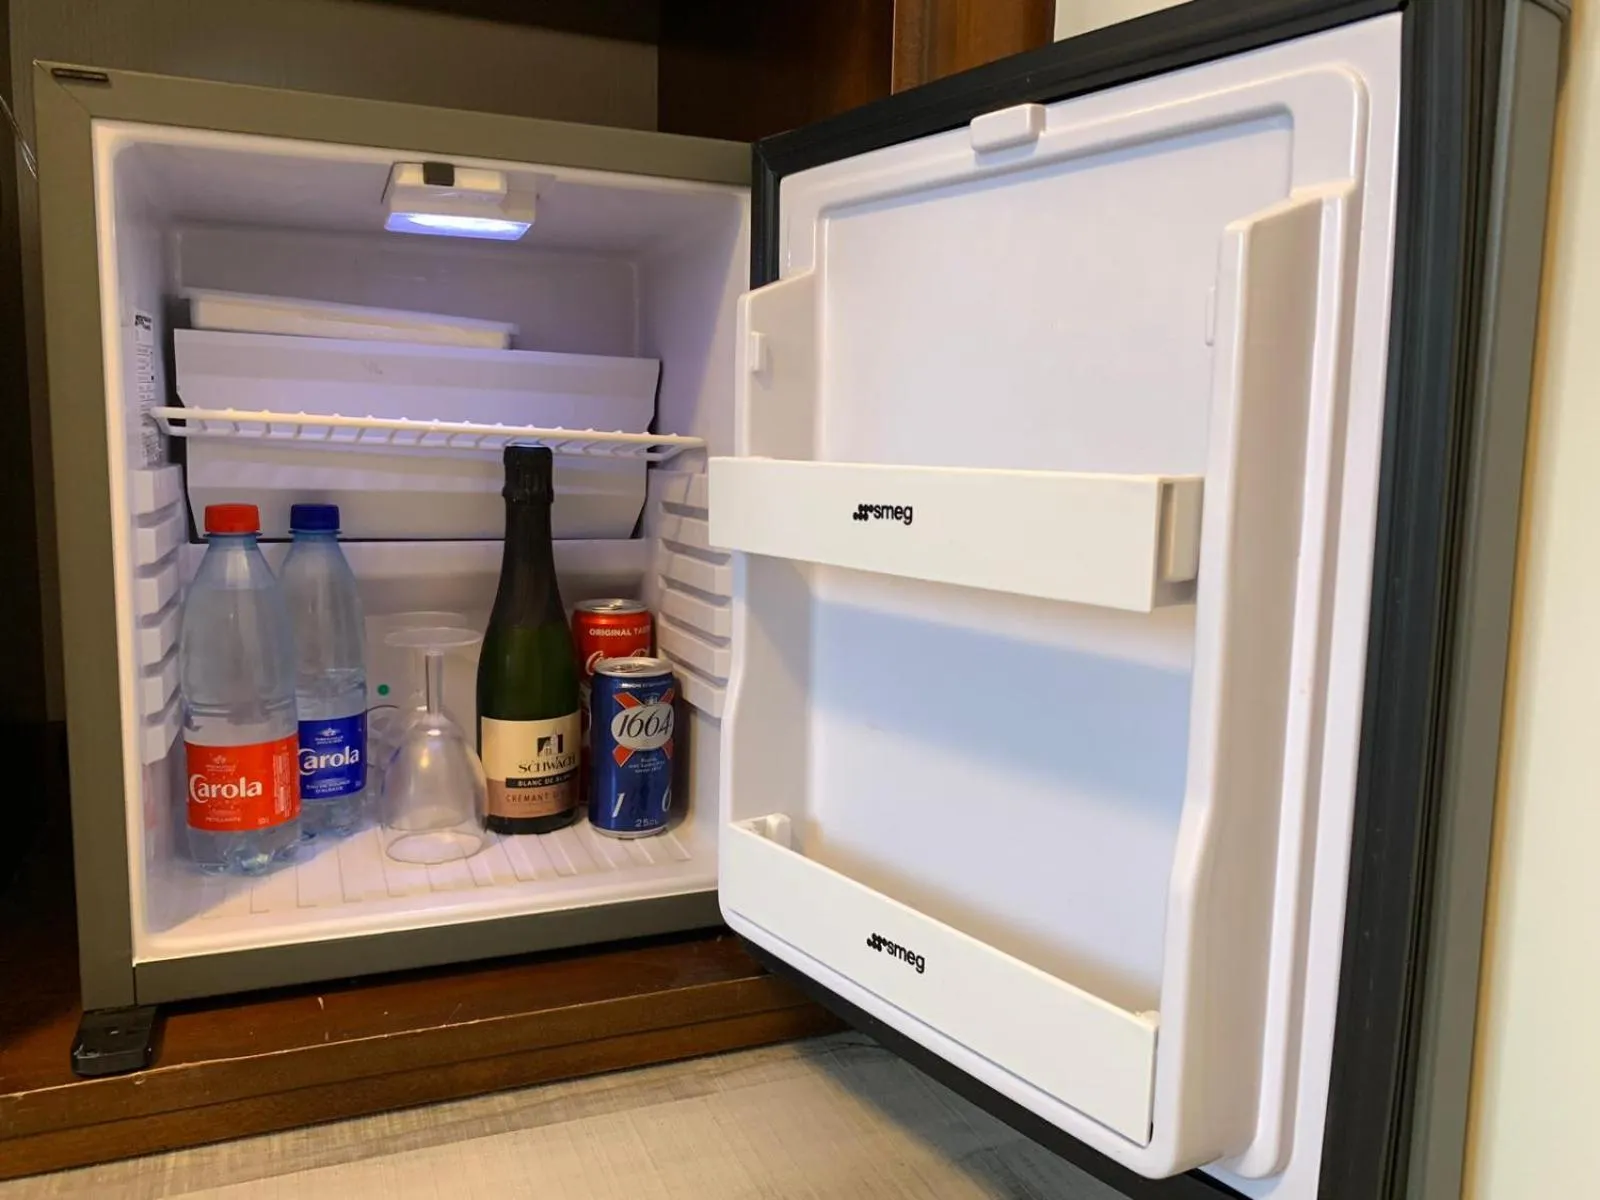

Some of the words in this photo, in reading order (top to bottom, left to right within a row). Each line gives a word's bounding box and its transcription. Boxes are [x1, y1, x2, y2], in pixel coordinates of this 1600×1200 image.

[873, 504, 913, 526] smeg
[589, 627, 633, 637] ORIGINAL
[618, 710, 671, 738] 1664
[297, 745, 360, 775] Carola
[189, 774, 263, 803] Carola
[517, 778, 543, 788] BLANC
[886, 940, 925, 974] smeg
